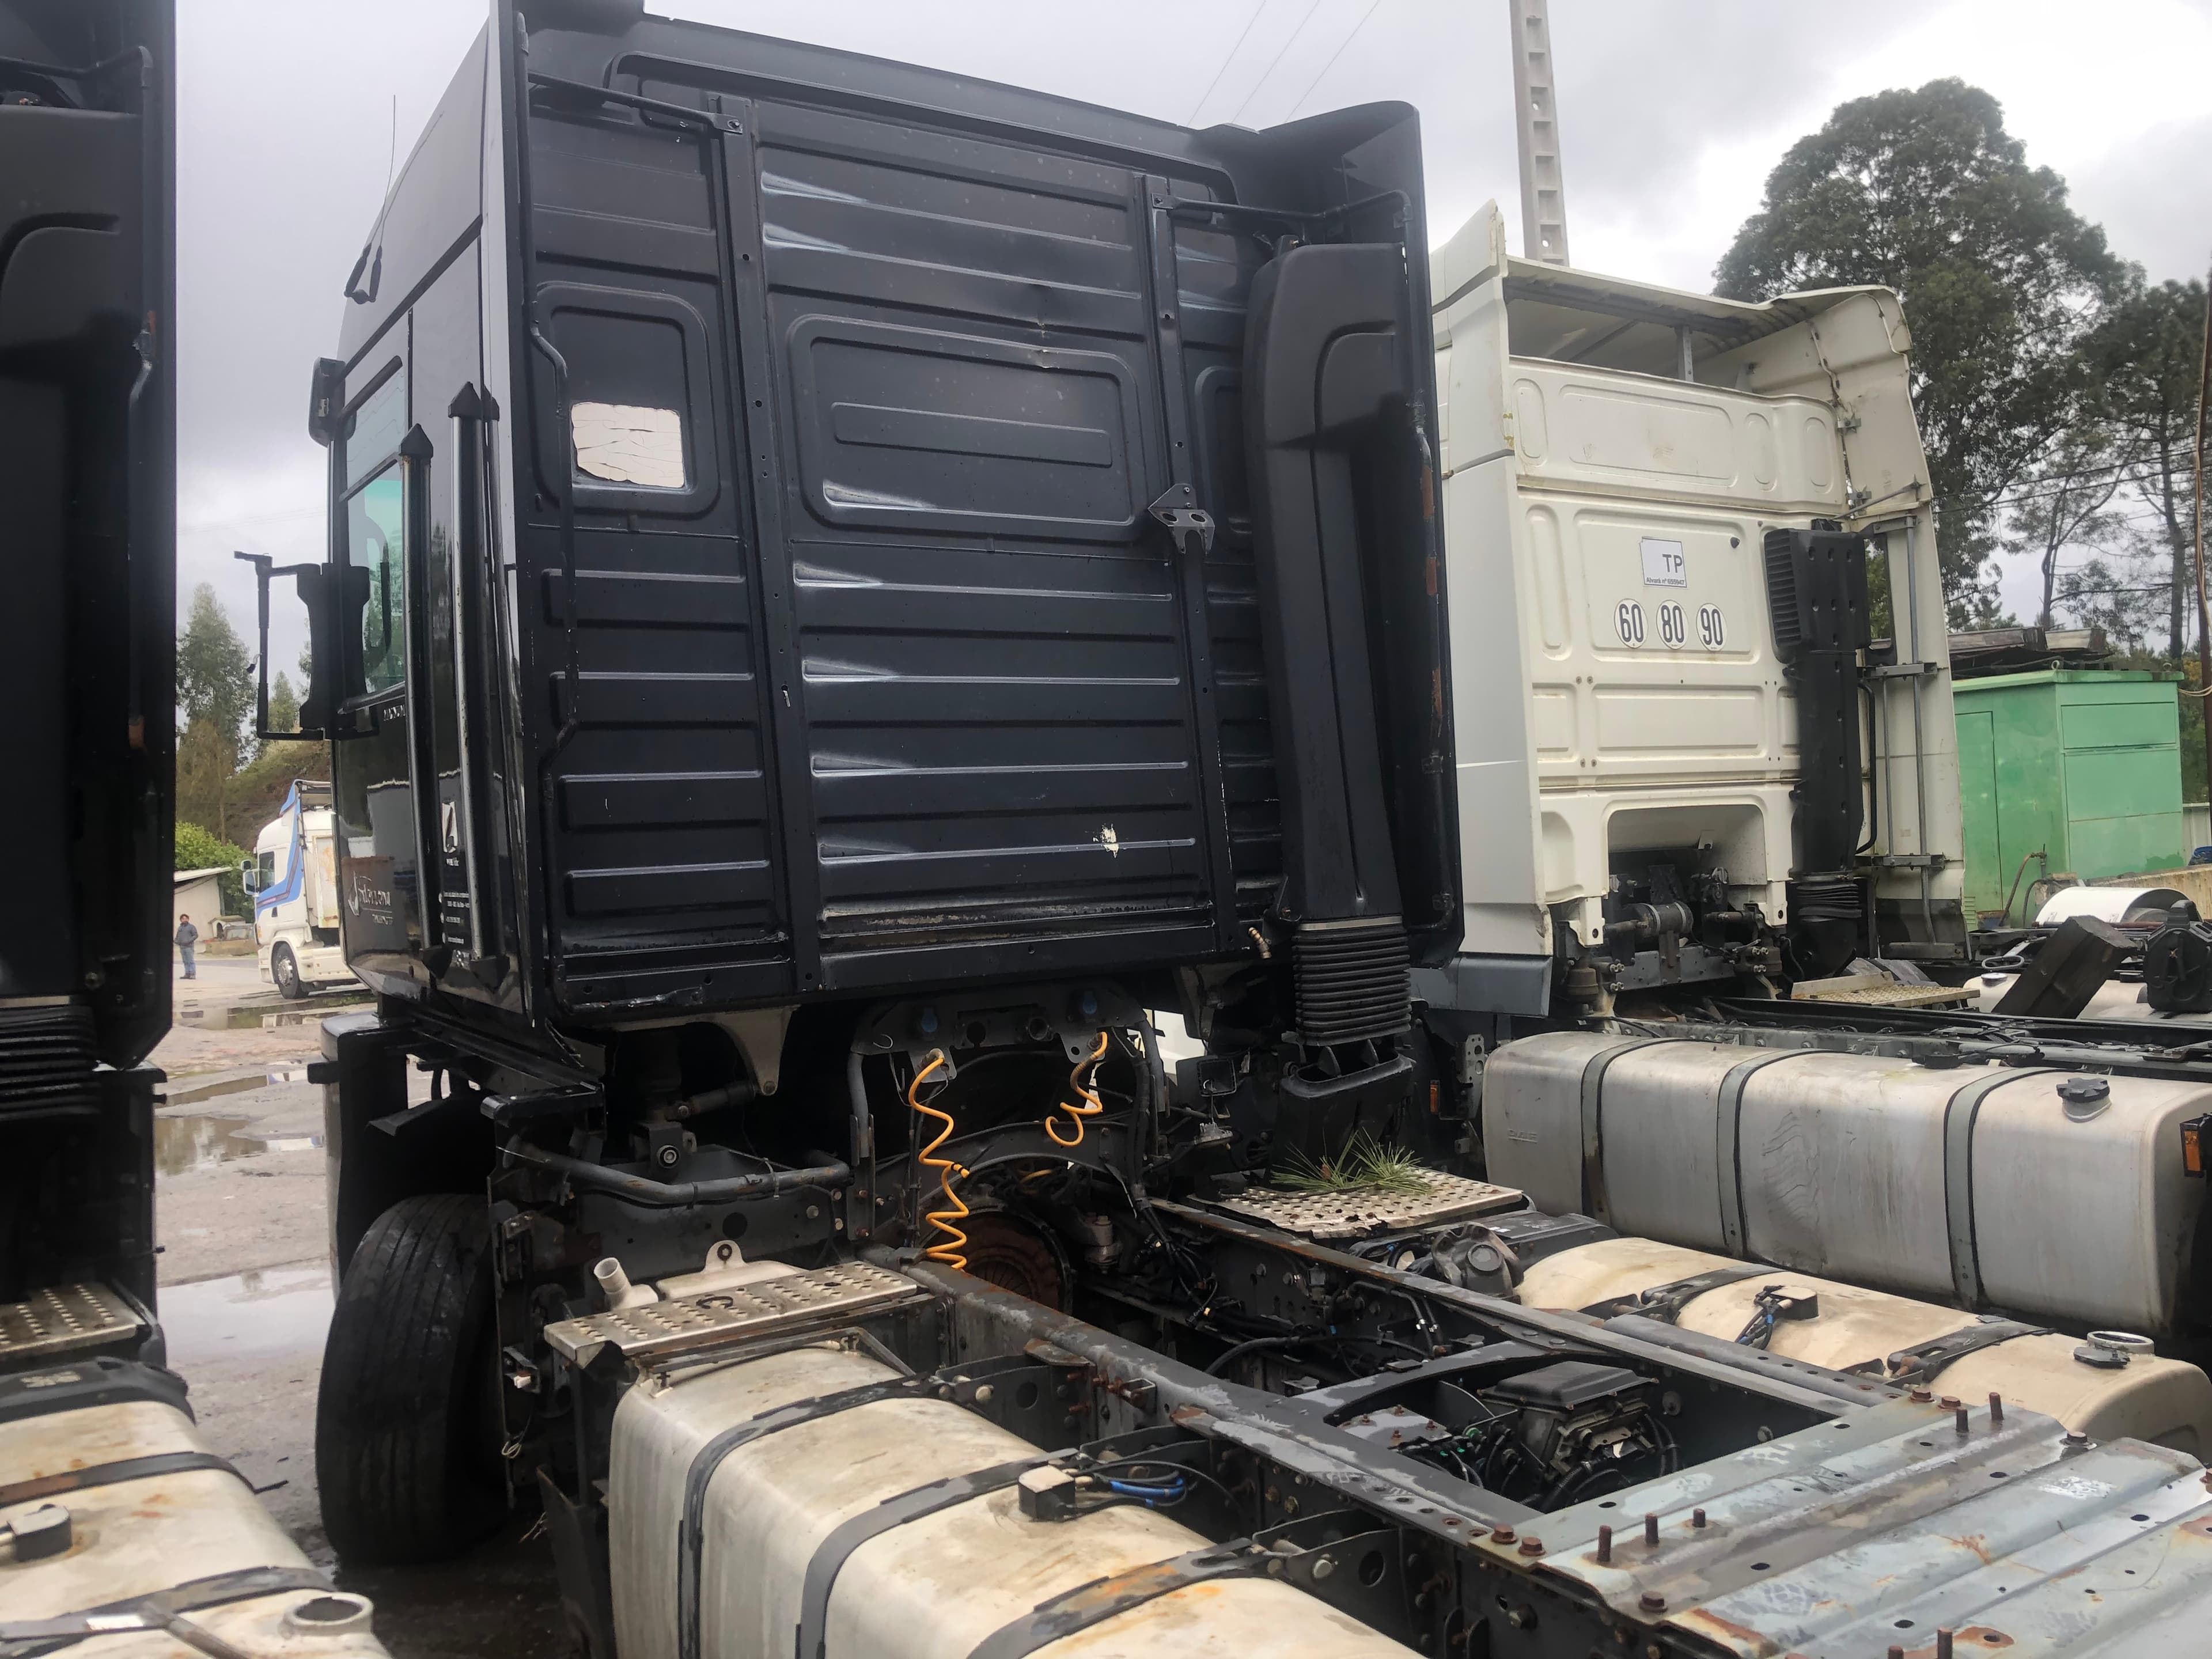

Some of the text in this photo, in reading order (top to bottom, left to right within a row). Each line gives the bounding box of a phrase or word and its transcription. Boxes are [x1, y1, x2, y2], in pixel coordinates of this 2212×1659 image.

[1662, 554, 1683, 573] TP
[1619, 604, 1644, 642] 60
[1661, 605, 1684, 643] 80
[1700, 608, 1724, 646] 90
